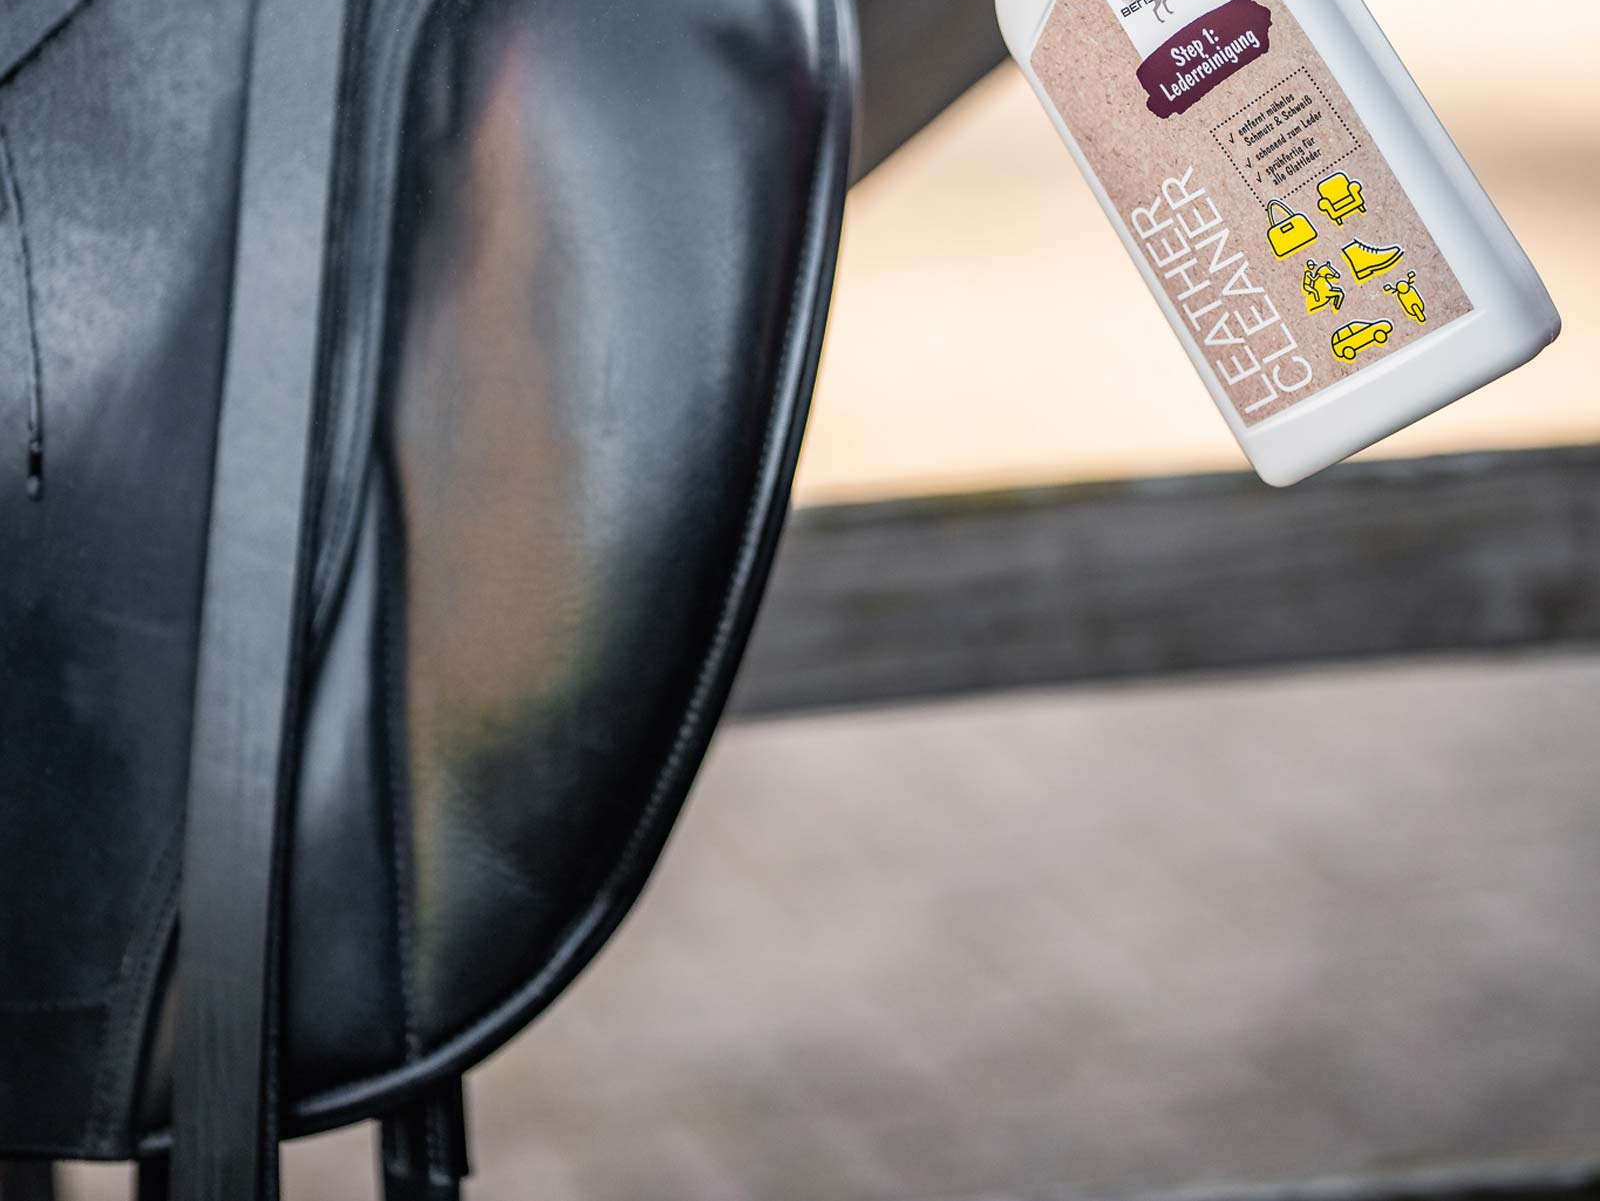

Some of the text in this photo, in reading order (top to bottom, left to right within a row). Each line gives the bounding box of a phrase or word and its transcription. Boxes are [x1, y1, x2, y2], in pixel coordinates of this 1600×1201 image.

[1159, 30, 1260, 102] Lederreinigung
[1170, 28, 1219, 67] Step 1:
[1238, 94, 1295, 136] entfernt mühelos
[1244, 95, 1313, 146] Schmutz & Schweiß
[1255, 111, 1322, 160] schonend zum Leder
[1265, 137, 1315, 175] sprühfertig für
[1272, 148, 1322, 185] alle Glattleder
[1162, 165, 1312, 392] CLEANER
[1131, 196, 1278, 413] LEATHER
